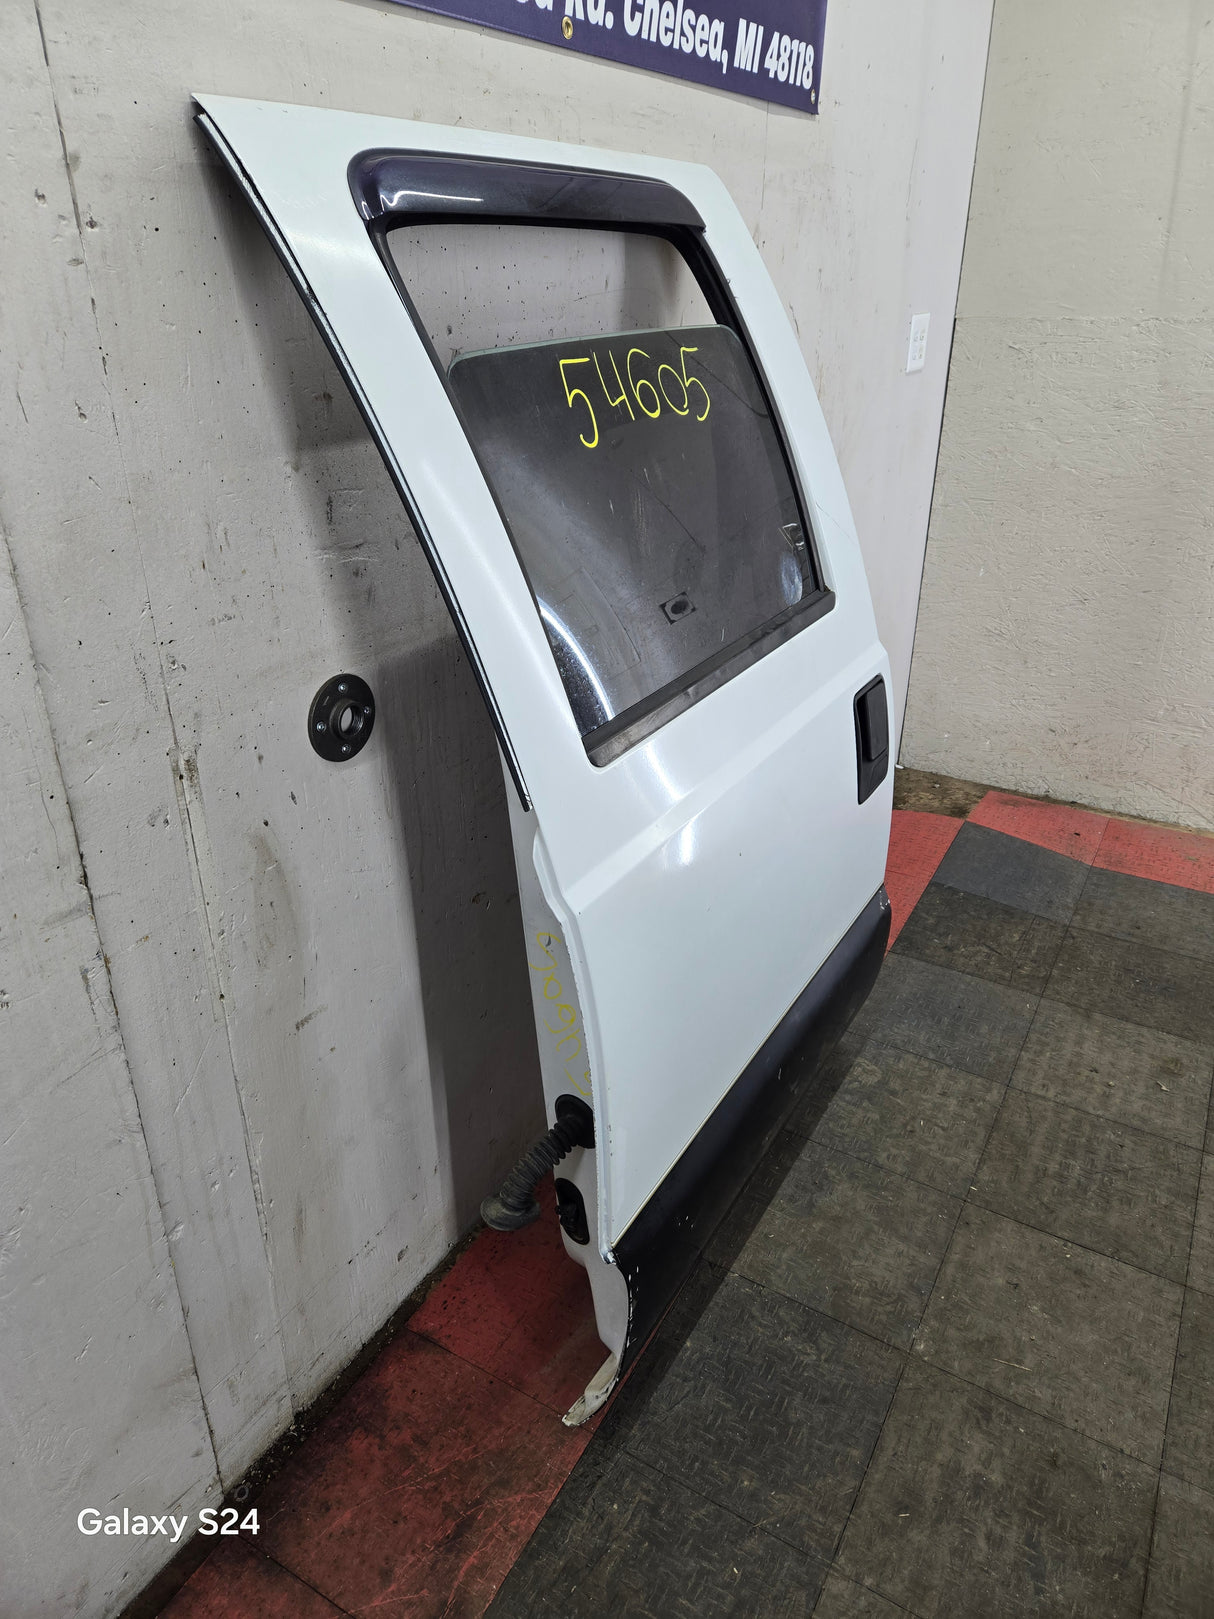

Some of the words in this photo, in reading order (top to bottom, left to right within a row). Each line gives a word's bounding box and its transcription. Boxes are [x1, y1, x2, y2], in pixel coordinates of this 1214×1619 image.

[624, 0, 728, 74] Chelsea,
[734, 18, 764, 73] MI
[764, 31, 814, 90] 48118
[559, 346, 710, 448] 54605
